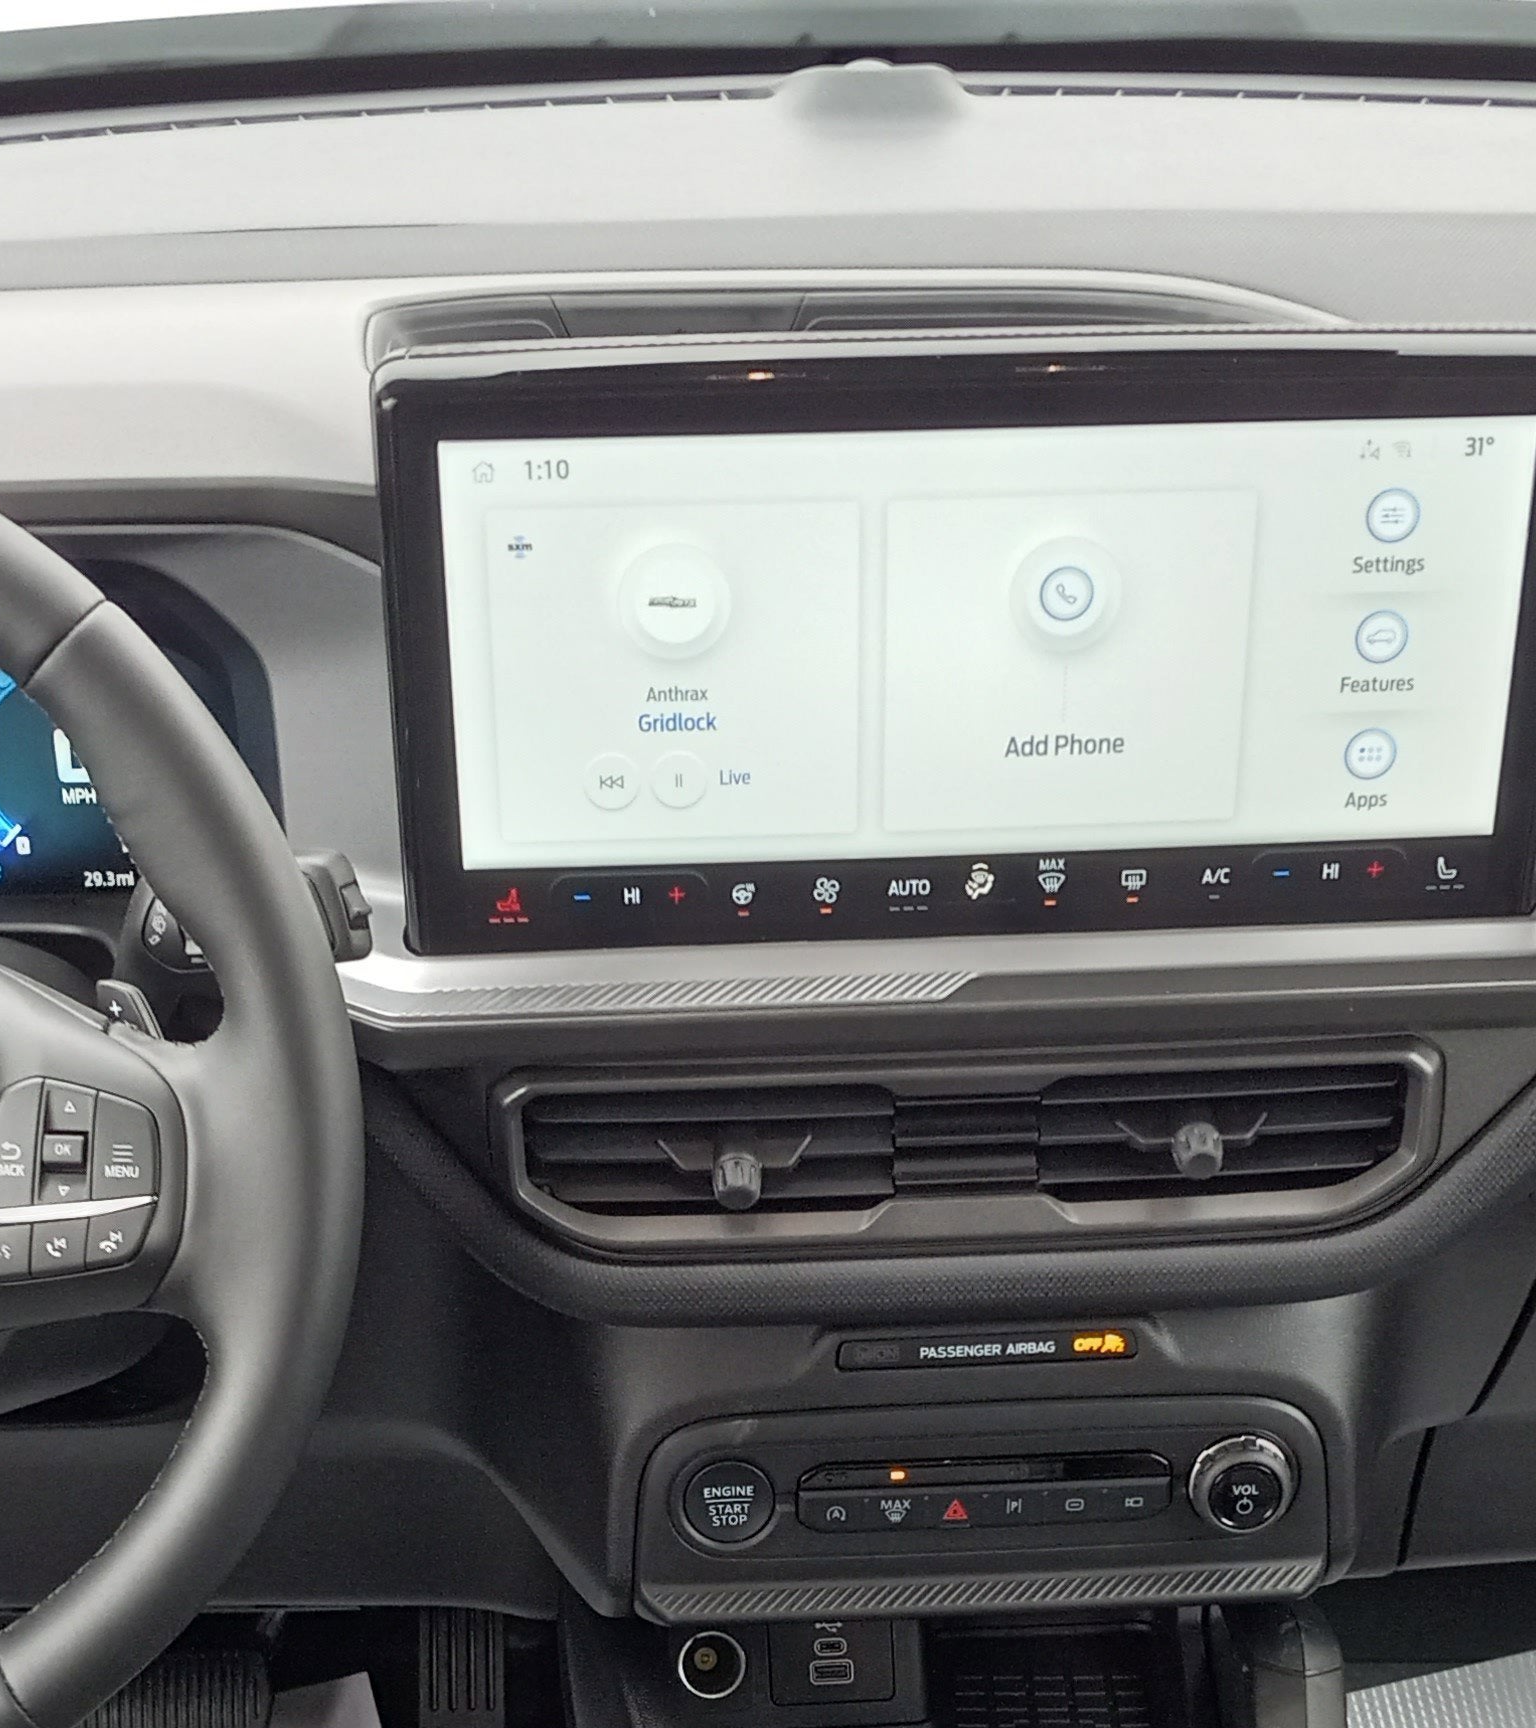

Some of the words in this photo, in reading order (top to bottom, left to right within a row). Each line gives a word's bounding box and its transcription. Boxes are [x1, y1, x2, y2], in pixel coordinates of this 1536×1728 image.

[1464, 434, 1496, 457] 31°
[523, 459, 570, 482] 1:10
[1352, 553, 1425, 578] Settings
[1339, 673, 1415, 696] Features
[646, 686, 709, 702] Anthrax
[638, 712, 718, 732] Gridlock
[1004, 733, 1051, 761] Add
[1055, 732, 1125, 759] Phone
[719, 769, 751, 786] Live
[61, 787, 98, 805] MPH
[1344, 788, 1388, 812] Apps
[1039, 859, 1065, 872] MAX
[1322, 863, 1340, 880] HI
[1202, 867, 1232, 886] A/C
[624, 886, 641, 904] HI
[888, 878, 931, 897] AUTO
[55, 1143, 72, 1156] OK
[104, 1165, 140, 1178] MENU
[919, 1343, 1001, 1359] PASSENGER
[1005, 1340, 1056, 1355] AIRBAG
[1073, 1338, 1102, 1352] OFF
[703, 1485, 755, 1498] ENGINE
[1232, 1484, 1259, 1496] VOL
[708, 1504, 750, 1516] START
[880, 1499, 912, 1510] MAX
[712, 1514, 748, 1527] STOP
